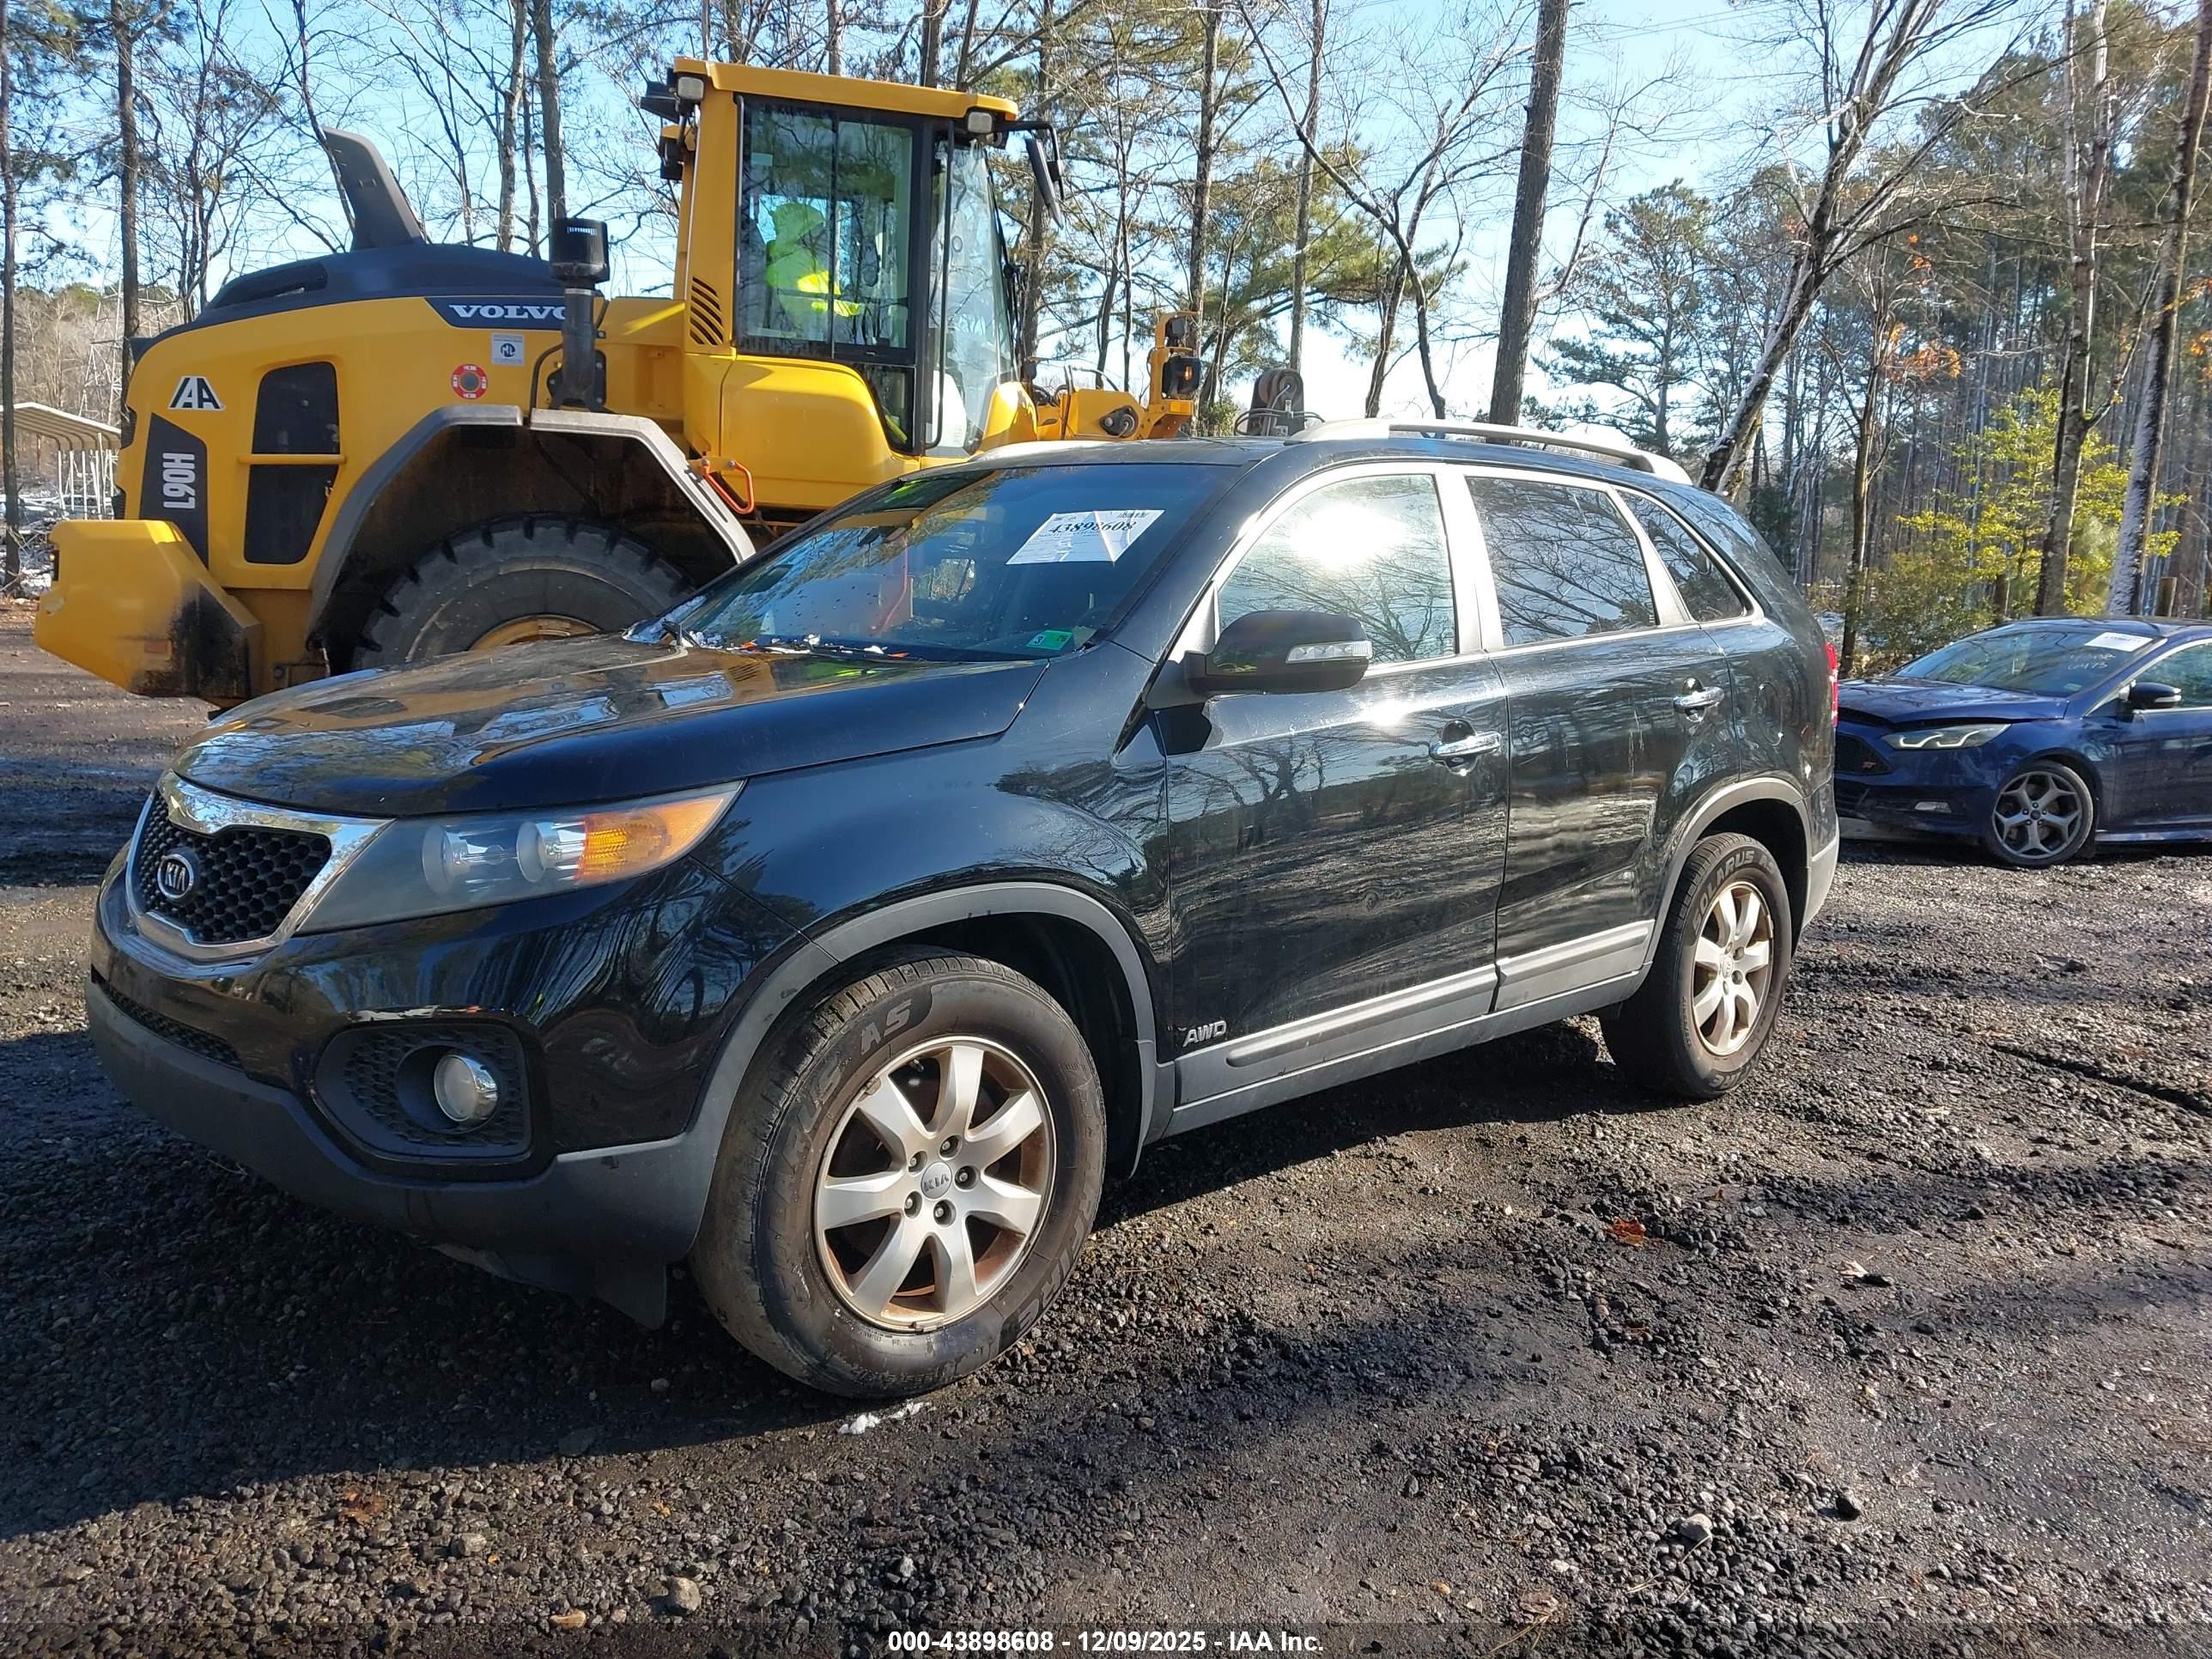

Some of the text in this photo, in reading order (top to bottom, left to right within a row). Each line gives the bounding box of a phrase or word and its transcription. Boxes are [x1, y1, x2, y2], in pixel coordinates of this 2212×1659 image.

[161, 452, 197, 510] L90H
[1048, 520, 1136, 534] 43898608
[165, 862, 186, 891] KIA
[1692, 849, 1755, 935] SOLARUS
[860, 999, 914, 1055] AS
[1182, 1019, 1228, 1048] AWD
[922, 1172, 951, 1194] KIA
